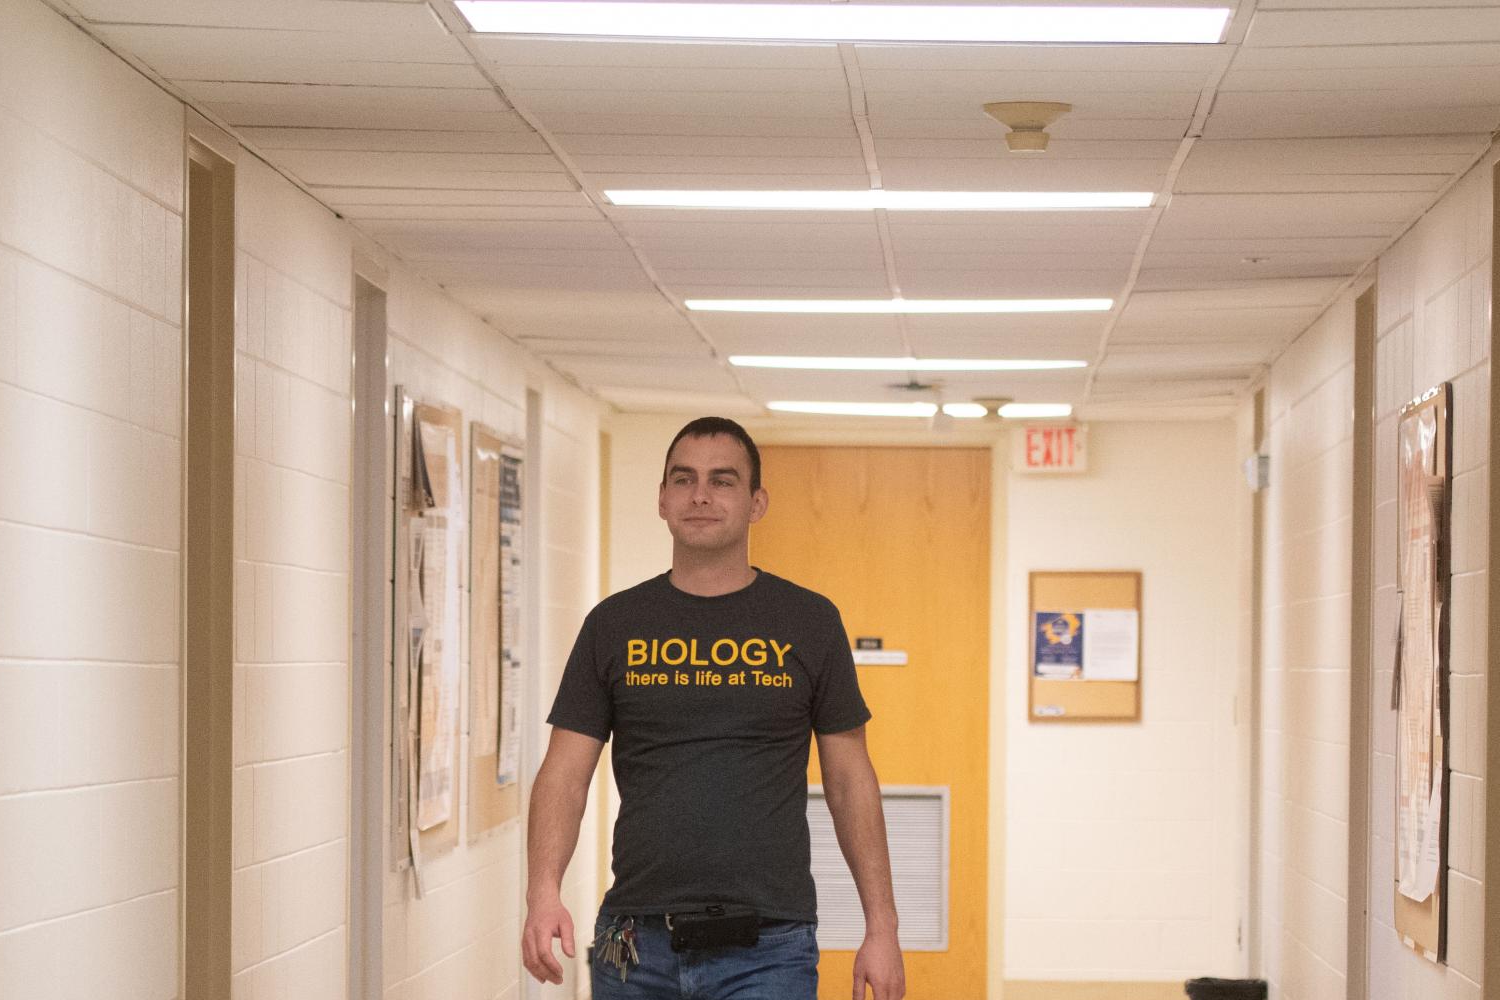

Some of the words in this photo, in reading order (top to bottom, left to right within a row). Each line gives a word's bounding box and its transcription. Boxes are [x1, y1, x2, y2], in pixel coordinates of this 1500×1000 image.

[1026, 427, 1077, 467] EXIT
[627, 638, 792, 667] BIOLOGY
[626, 671, 669, 686] there
[675, 670, 690, 686] is
[695, 671, 723, 686] life
[728, 671, 747, 686] at
[751, 671, 793, 688] Tech
